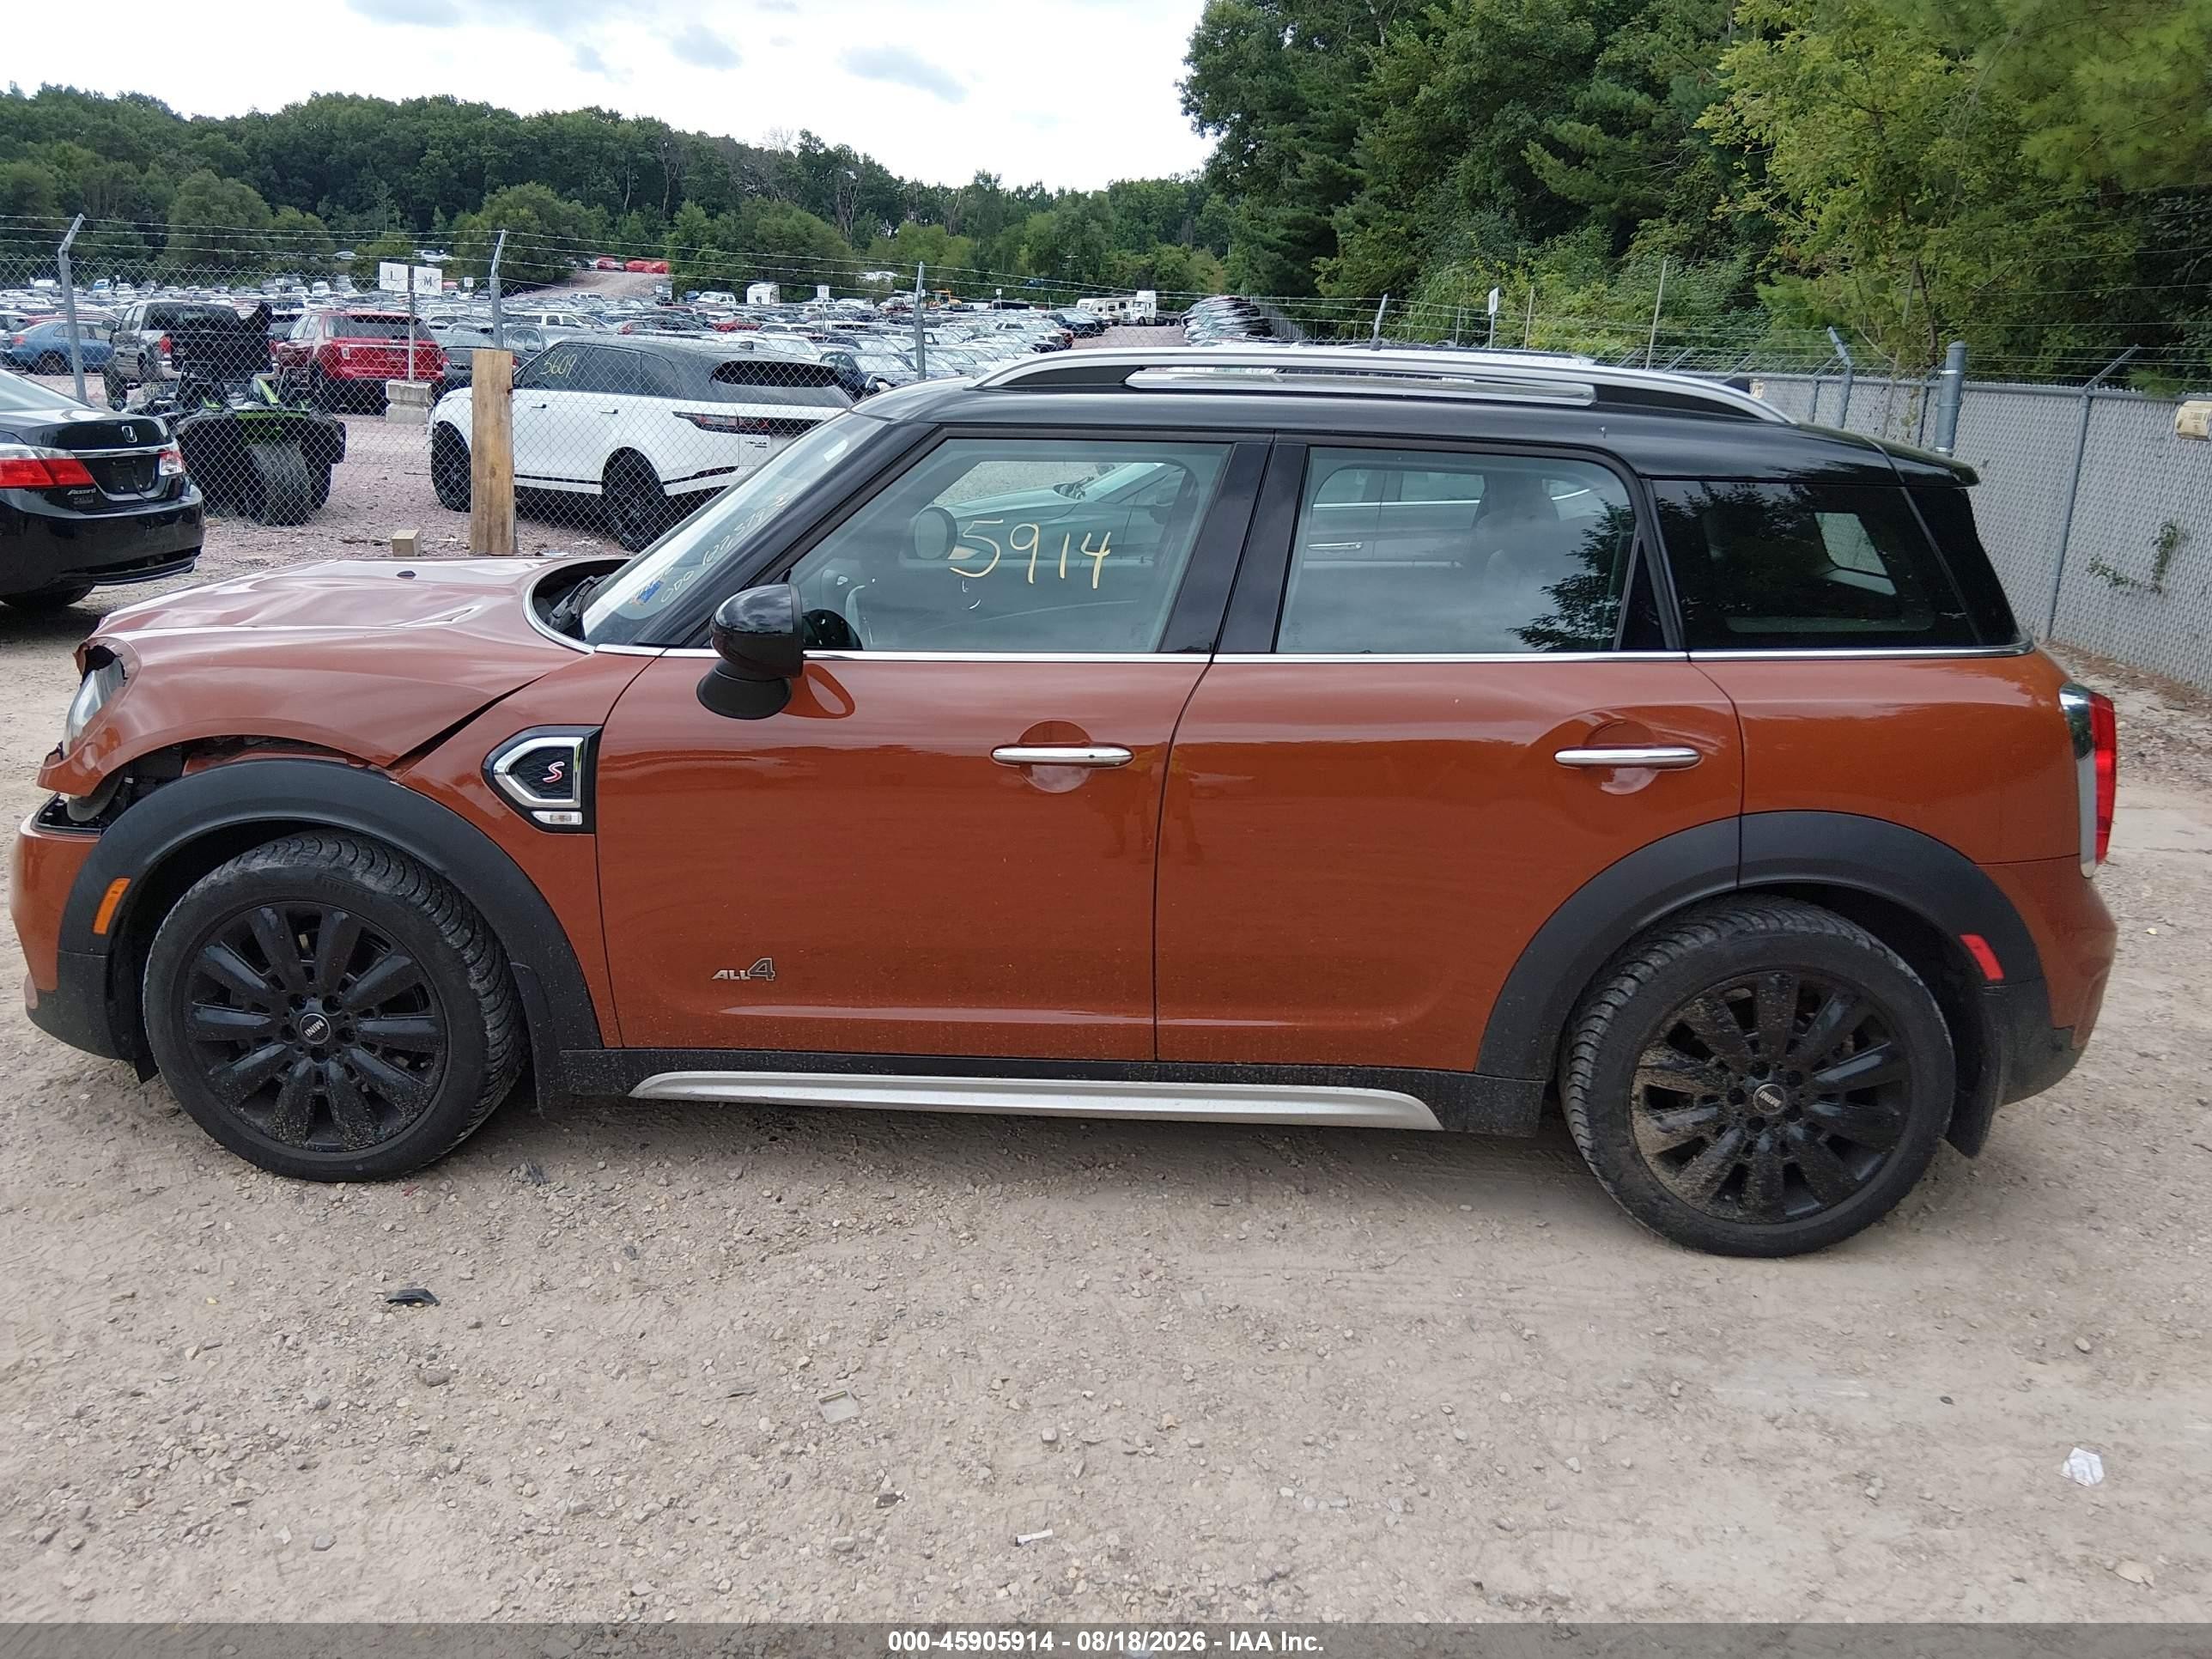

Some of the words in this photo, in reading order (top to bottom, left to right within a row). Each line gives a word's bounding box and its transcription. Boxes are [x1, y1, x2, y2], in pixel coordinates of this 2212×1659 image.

[539, 351, 578, 379] 5609
[949, 520, 1111, 589] 5914
[543, 762, 565, 783] S
[711, 957, 775, 981] ALL4
[304, 1019, 325, 1037] MINI
